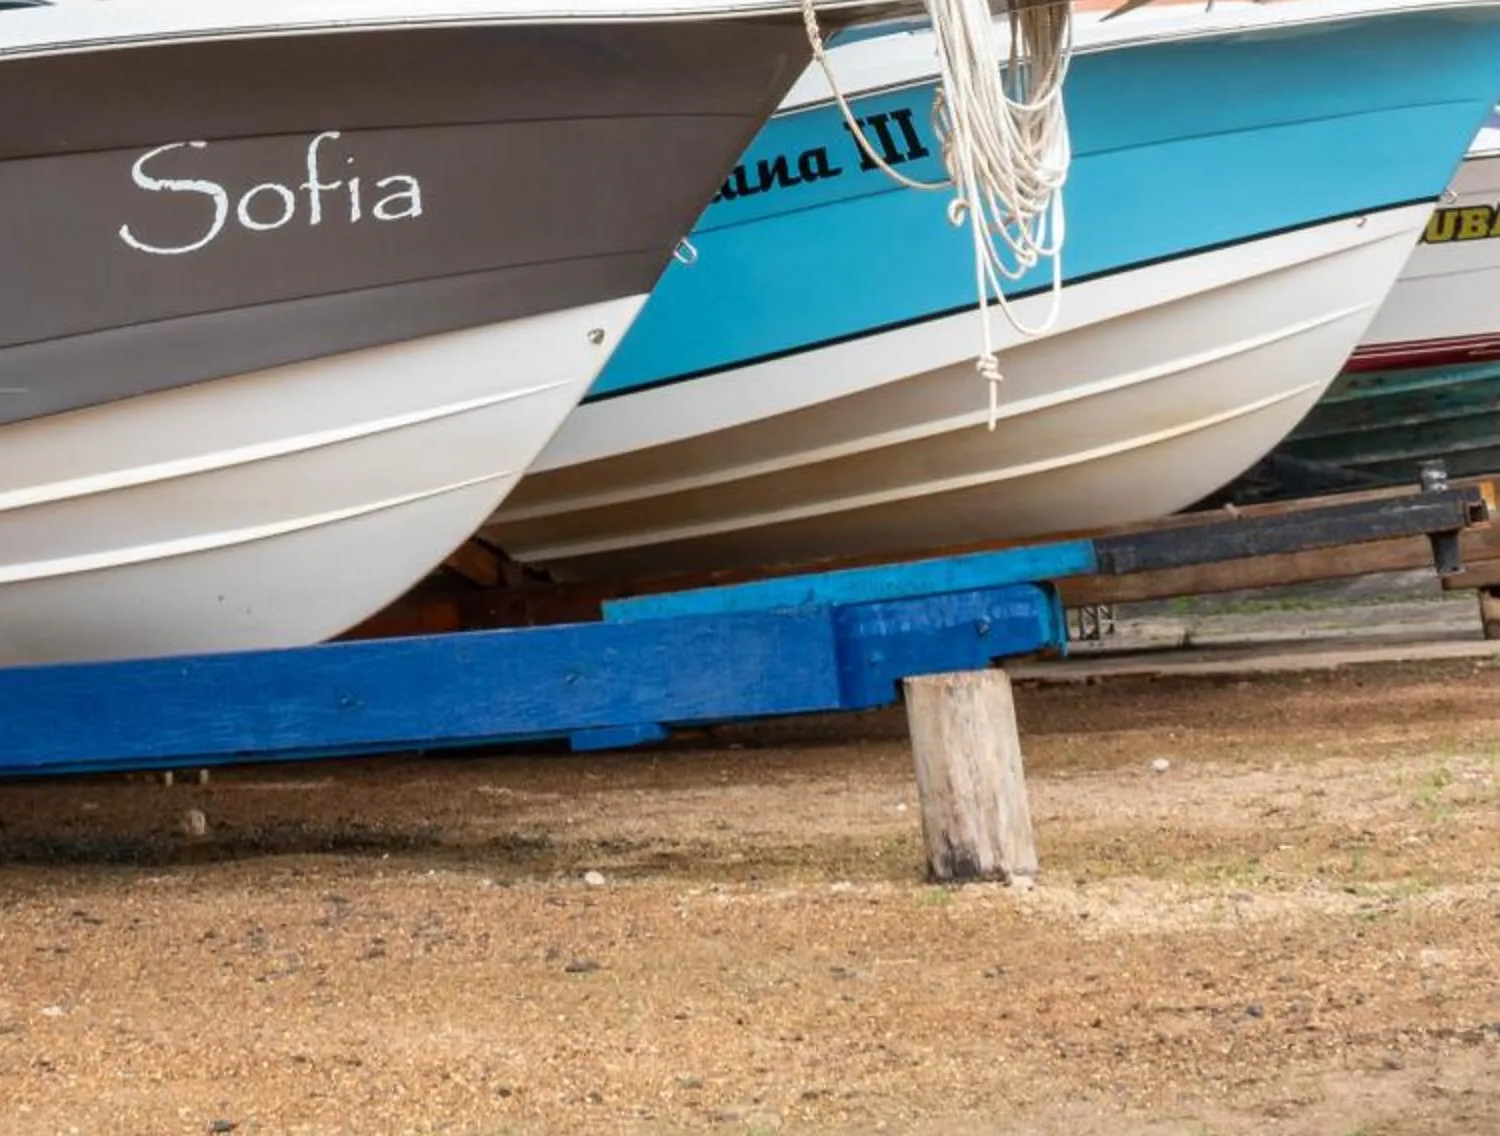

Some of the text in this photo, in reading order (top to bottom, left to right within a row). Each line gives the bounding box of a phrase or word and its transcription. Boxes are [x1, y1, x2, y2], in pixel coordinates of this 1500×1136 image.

[119, 131, 423, 254] Sofia
[711, 108, 930, 203] ana III
